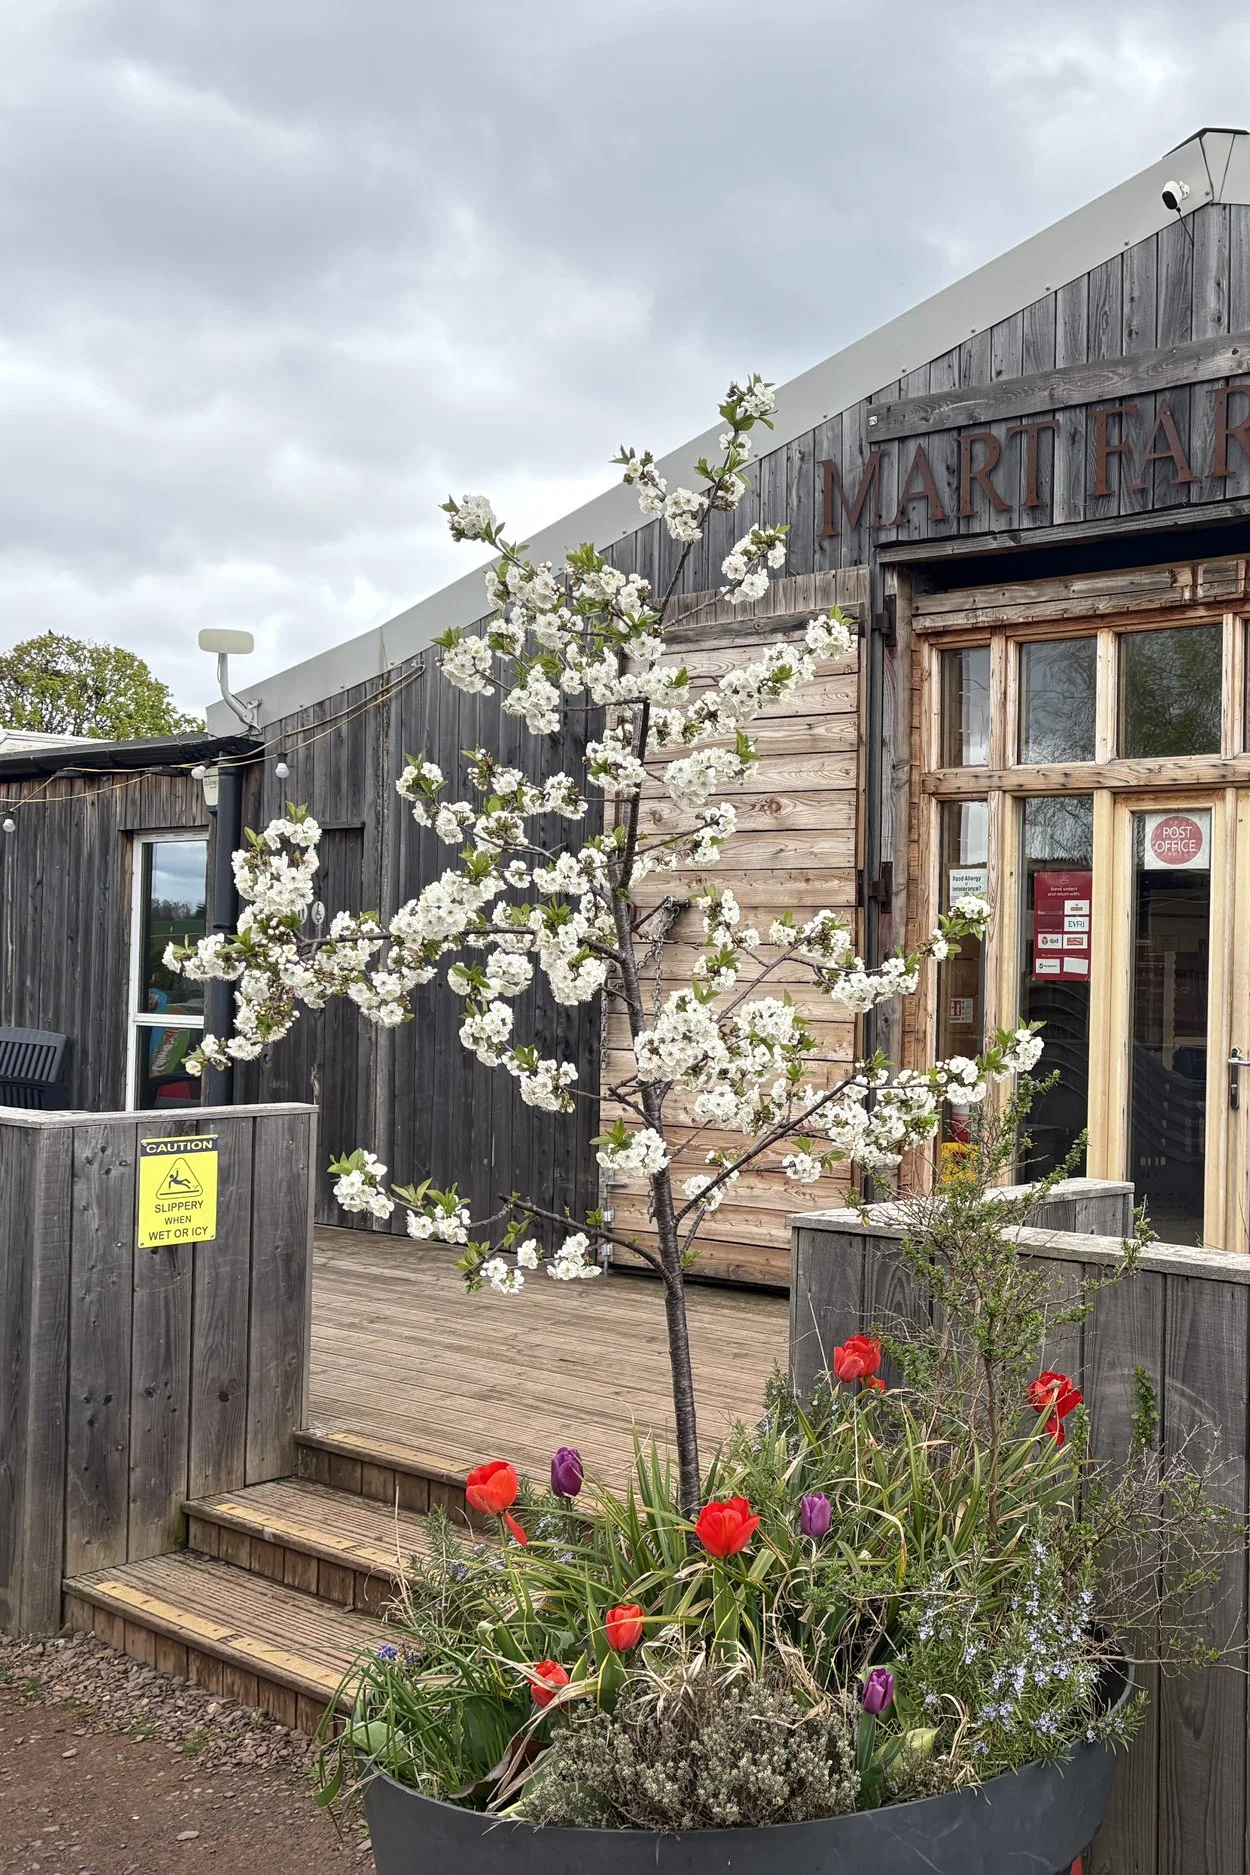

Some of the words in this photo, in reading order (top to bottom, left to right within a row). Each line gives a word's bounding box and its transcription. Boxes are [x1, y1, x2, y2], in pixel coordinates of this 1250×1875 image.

[816, 418, 1060, 537] MART
[1162, 826, 1193, 838] POST
[1155, 840, 1196, 853] OFFICE
[1068, 920, 1085, 928] EVRI
[146, 1140, 213, 1154] CAUTION
[154, 1200, 204, 1214] SLIPPERY
[164, 1215, 192, 1225] WHEN
[148, 1230, 172, 1241] WET
[174, 1228, 189, 1238] OR
[191, 1226, 208, 1237] ICY
